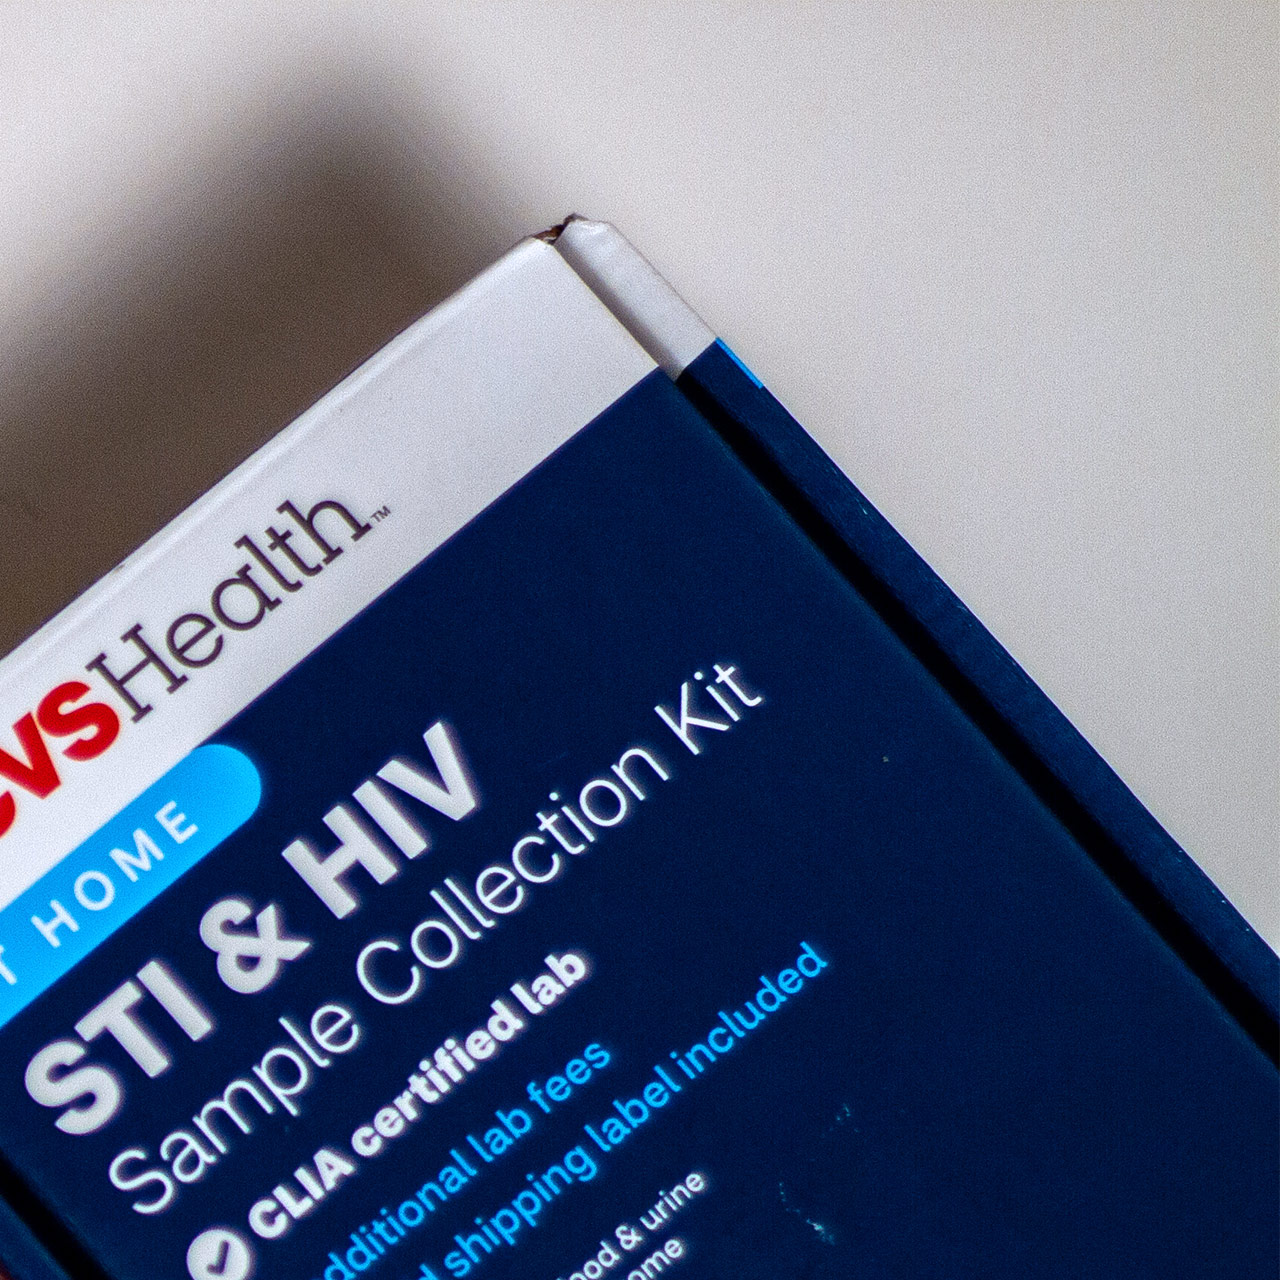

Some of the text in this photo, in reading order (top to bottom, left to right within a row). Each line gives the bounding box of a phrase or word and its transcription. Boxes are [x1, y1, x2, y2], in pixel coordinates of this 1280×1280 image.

[18, 720, 486, 1140] STI & HIV
[28, 798, 200, 949] HOME
[103, 658, 763, 1221] Sample Collection Kit
[244, 948, 590, 1242] CLIA certified lab
[438, 1141, 600, 1280] shipping
[582, 1062, 683, 1153] label
[667, 939, 830, 1080] included
[465, 1103, 535, 1164] lab
[524, 1038, 613, 1115] fees
[613, 1221, 644, 1252] &
[636, 1169, 707, 1232] urine
